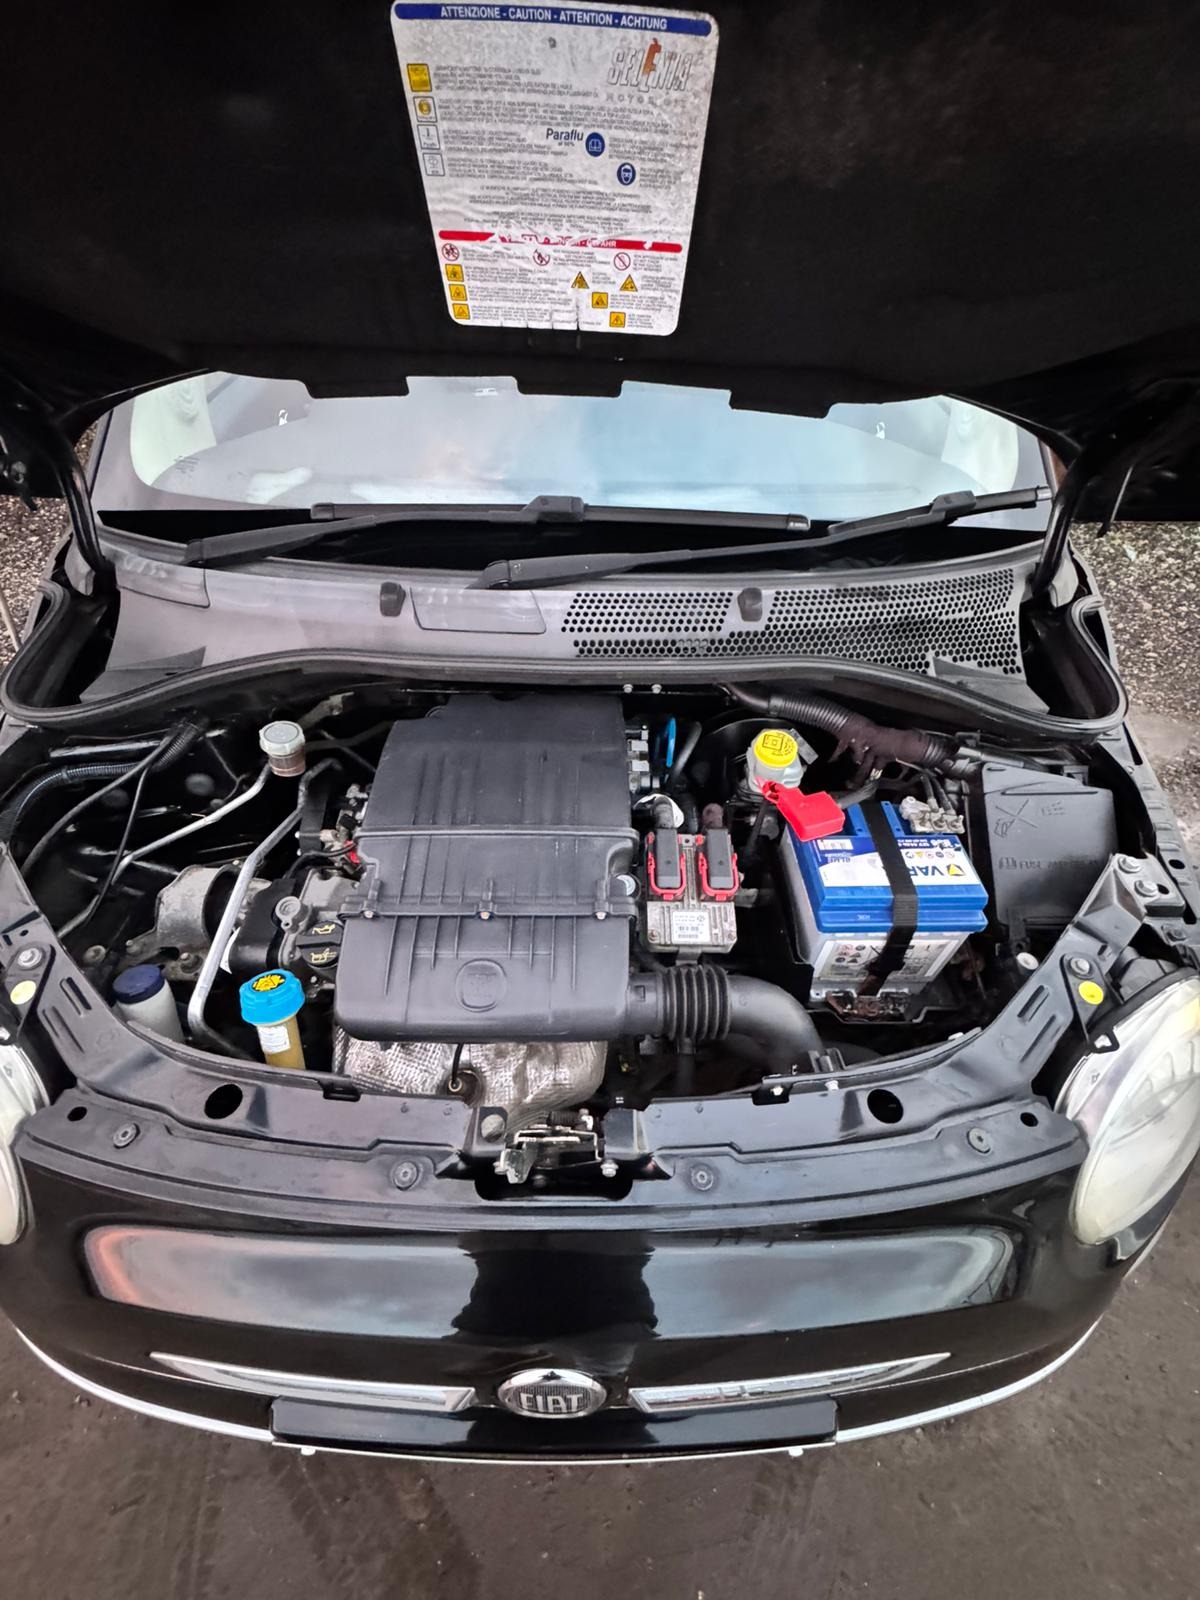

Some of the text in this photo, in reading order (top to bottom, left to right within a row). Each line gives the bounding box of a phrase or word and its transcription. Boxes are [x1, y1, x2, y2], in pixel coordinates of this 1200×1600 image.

[440, 6, 668, 30] ATTENZIONE CAUTION ATTENTION ACHTUNG
[546, 127, 584, 141] Paraflu
[909, 865, 945, 876] VAR
[520, 1392, 584, 1413] FIAT
